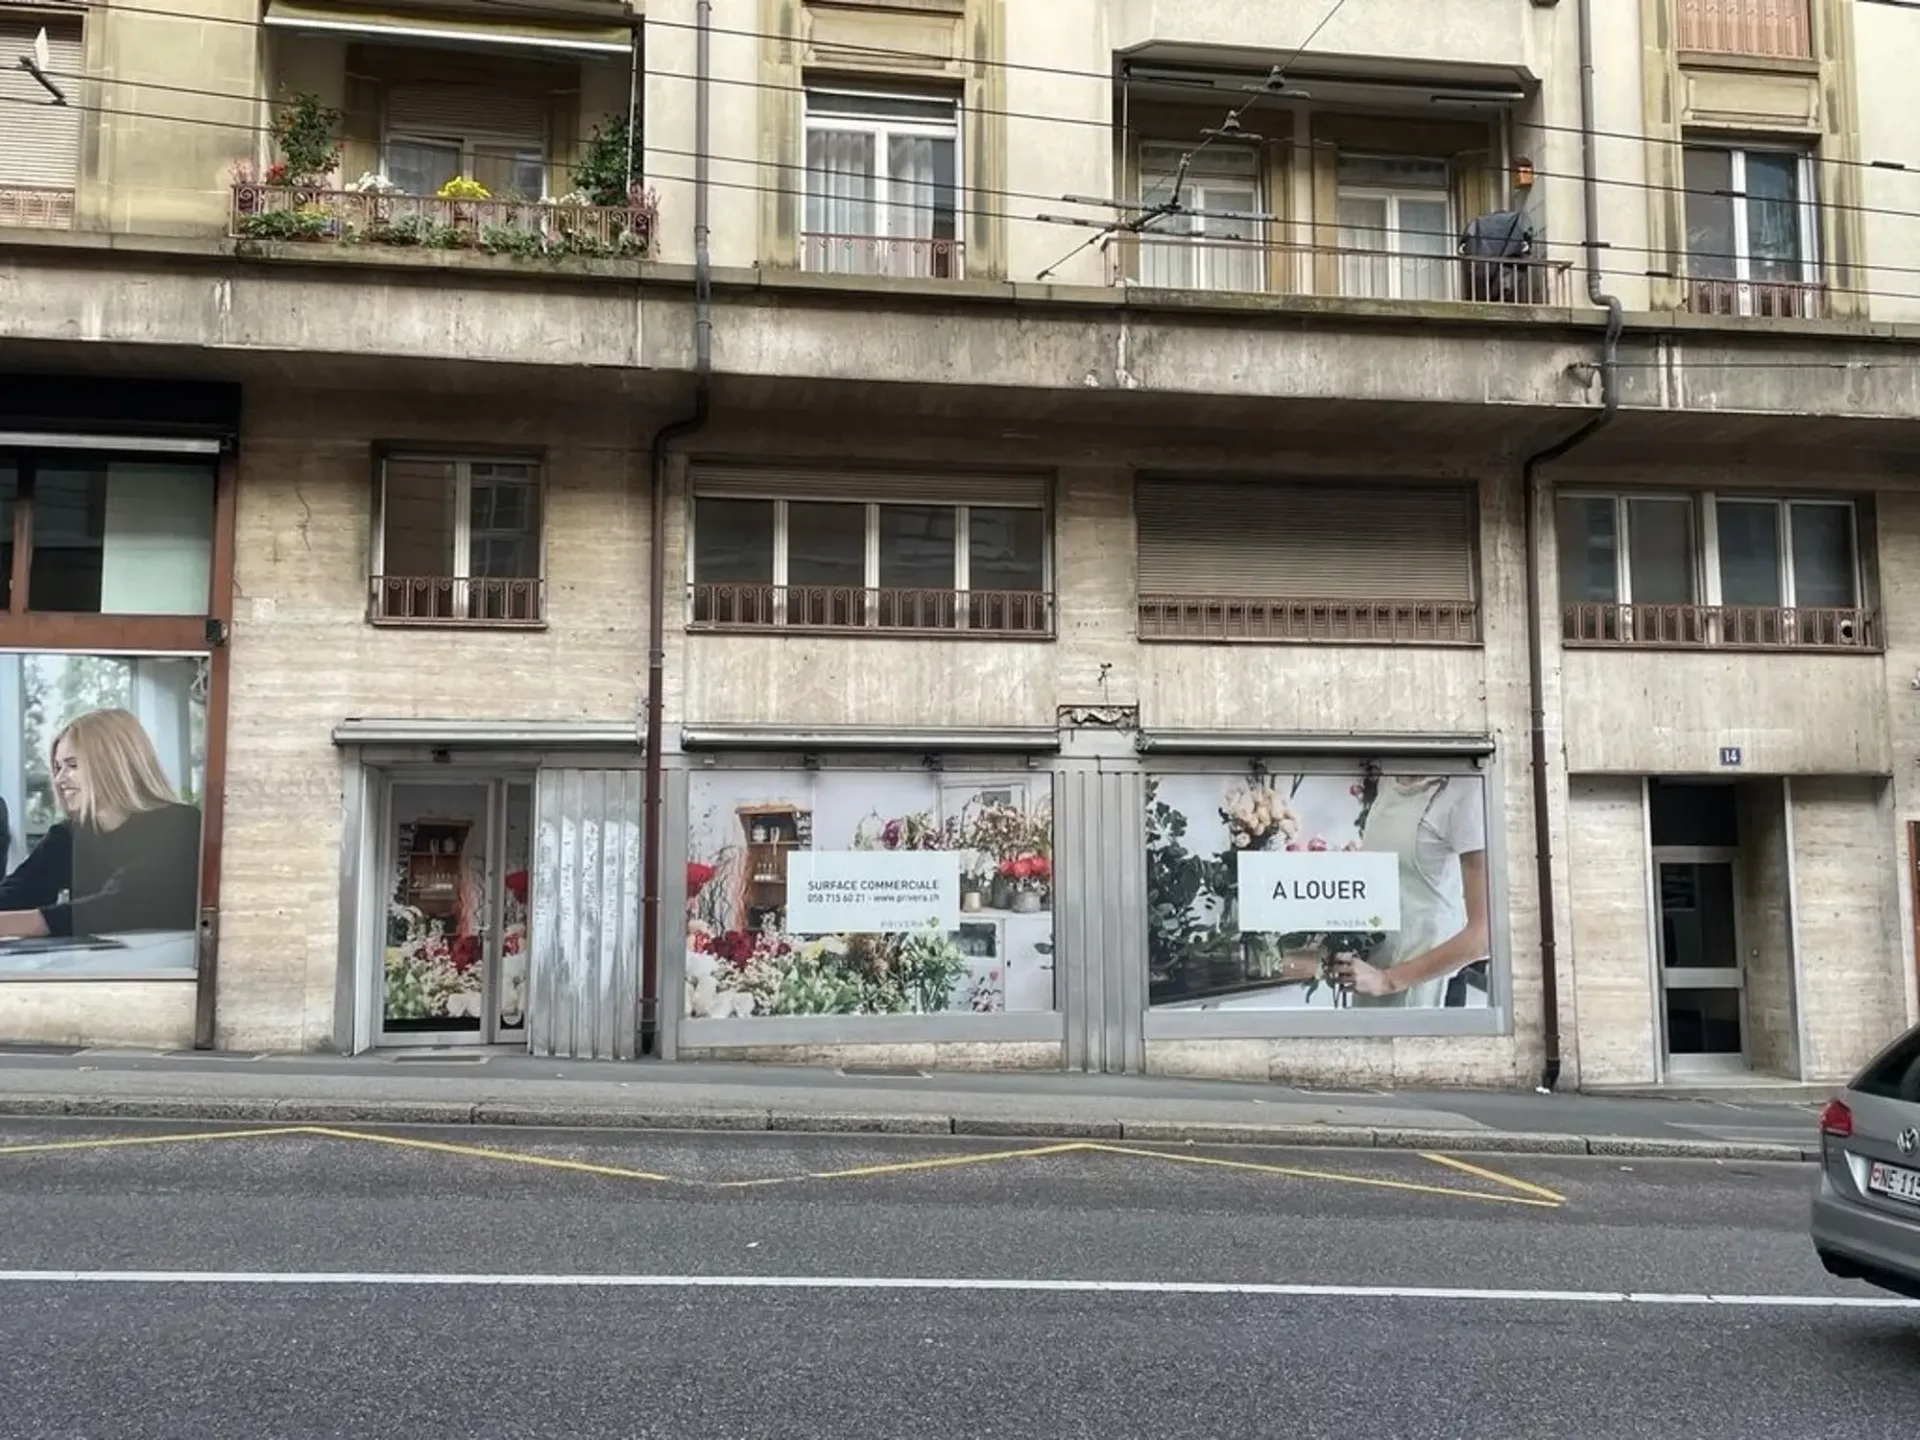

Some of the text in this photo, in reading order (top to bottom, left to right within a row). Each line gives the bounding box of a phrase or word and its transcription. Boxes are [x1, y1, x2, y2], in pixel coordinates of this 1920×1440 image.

[1725, 749, 1737, 762] 14
[808, 880, 939, 891] SURFACE COMMERCIALE
[1272, 881, 1366, 899] A LOUER
[808, 894, 823, 903] 058
[843, 894, 853, 903] 60
[856, 894, 865, 903] 21
[873, 894, 940, 904] www.privera.ch
